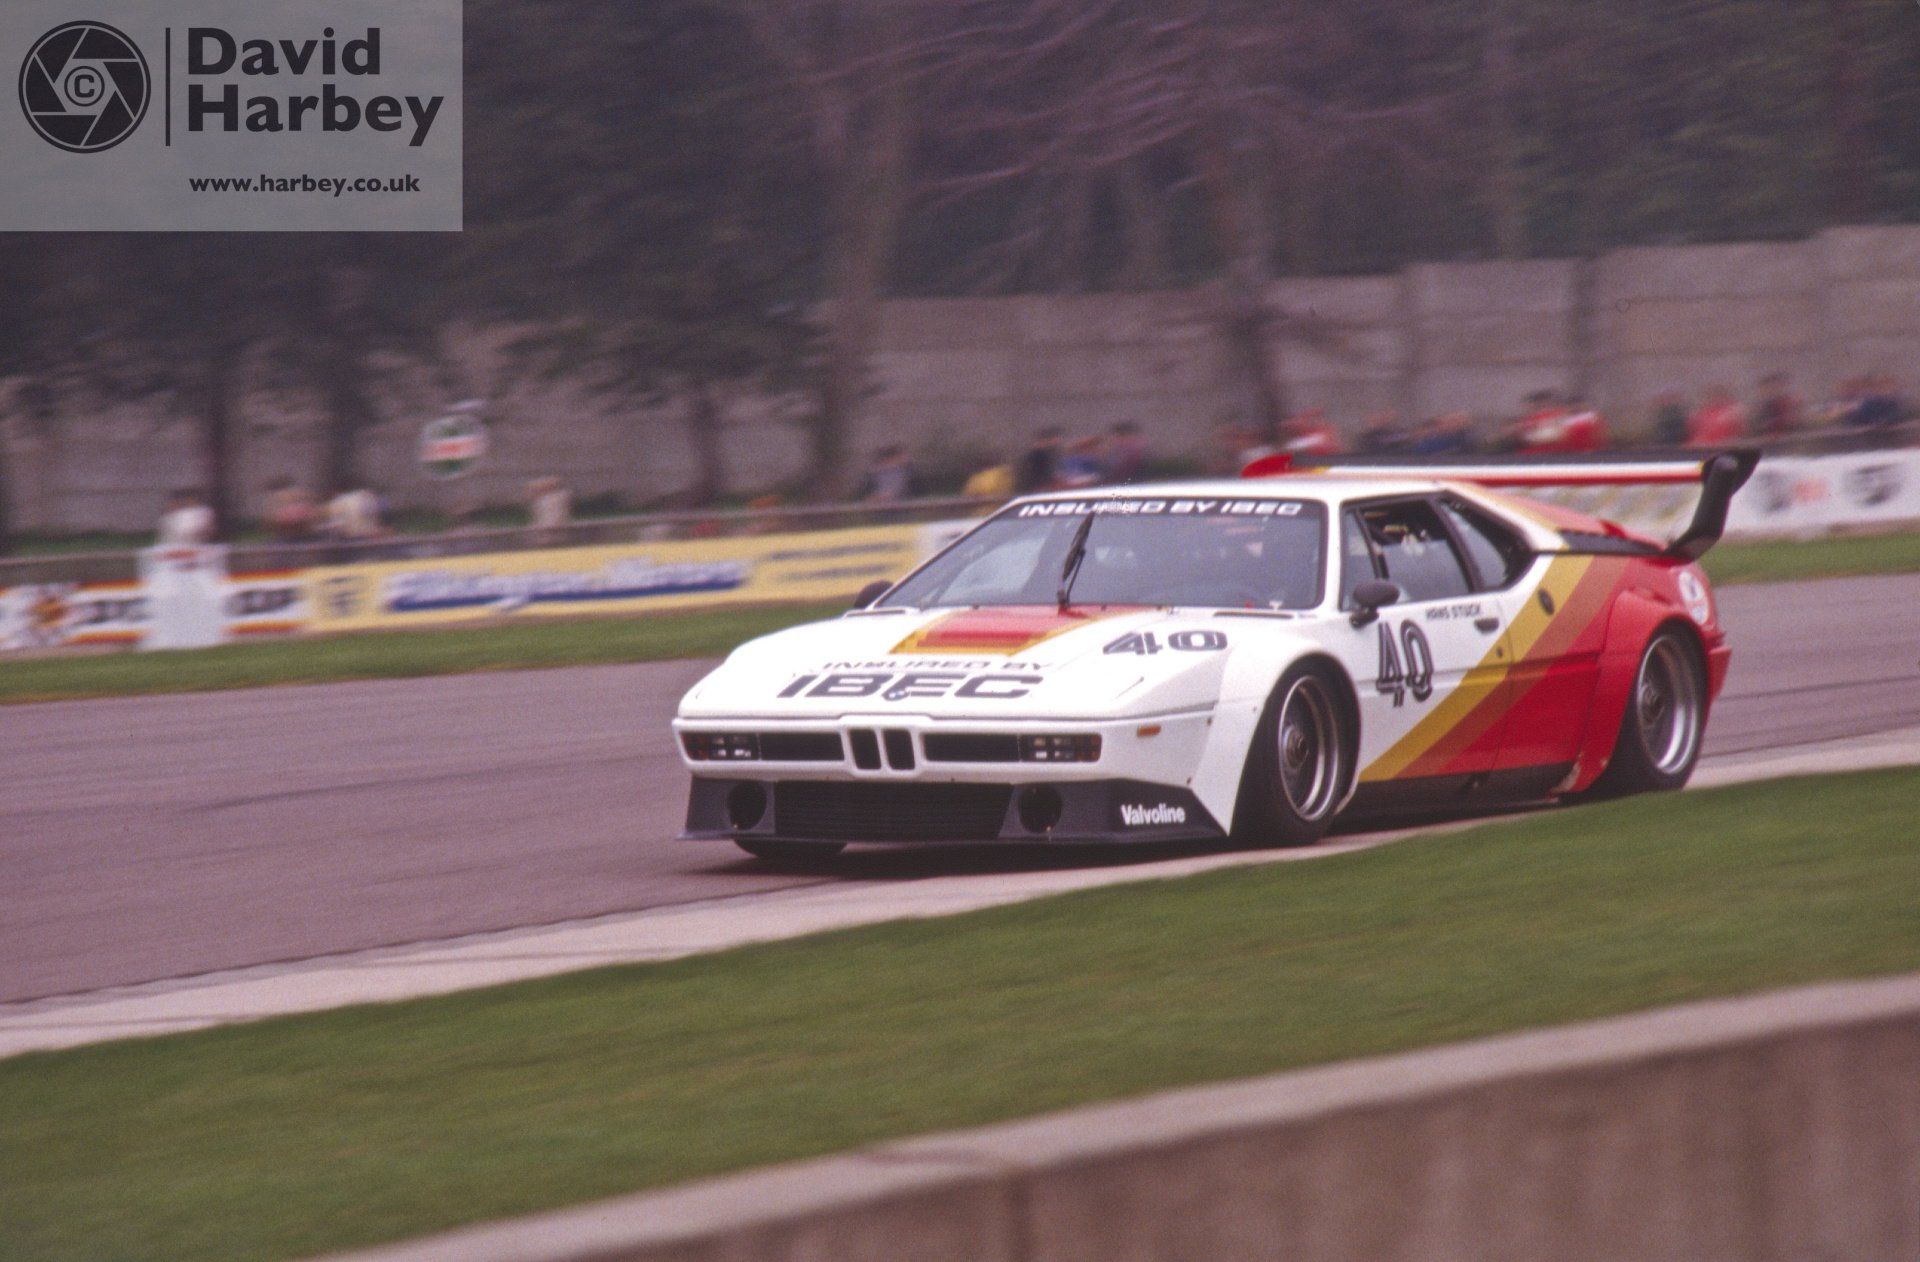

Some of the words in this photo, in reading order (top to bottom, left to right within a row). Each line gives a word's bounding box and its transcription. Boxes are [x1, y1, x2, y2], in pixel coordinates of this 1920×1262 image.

[1018, 501, 1167, 517] INSURED
[1169, 500, 1218, 514] BY
[1102, 630, 1228, 655] 40
[822, 660, 992, 670] INSURED
[1003, 661, 1053, 671] BY
[1375, 618, 1434, 708] 40
[776, 674, 1044, 699] IBEC
[1120, 802, 1186, 825] Valvoline
